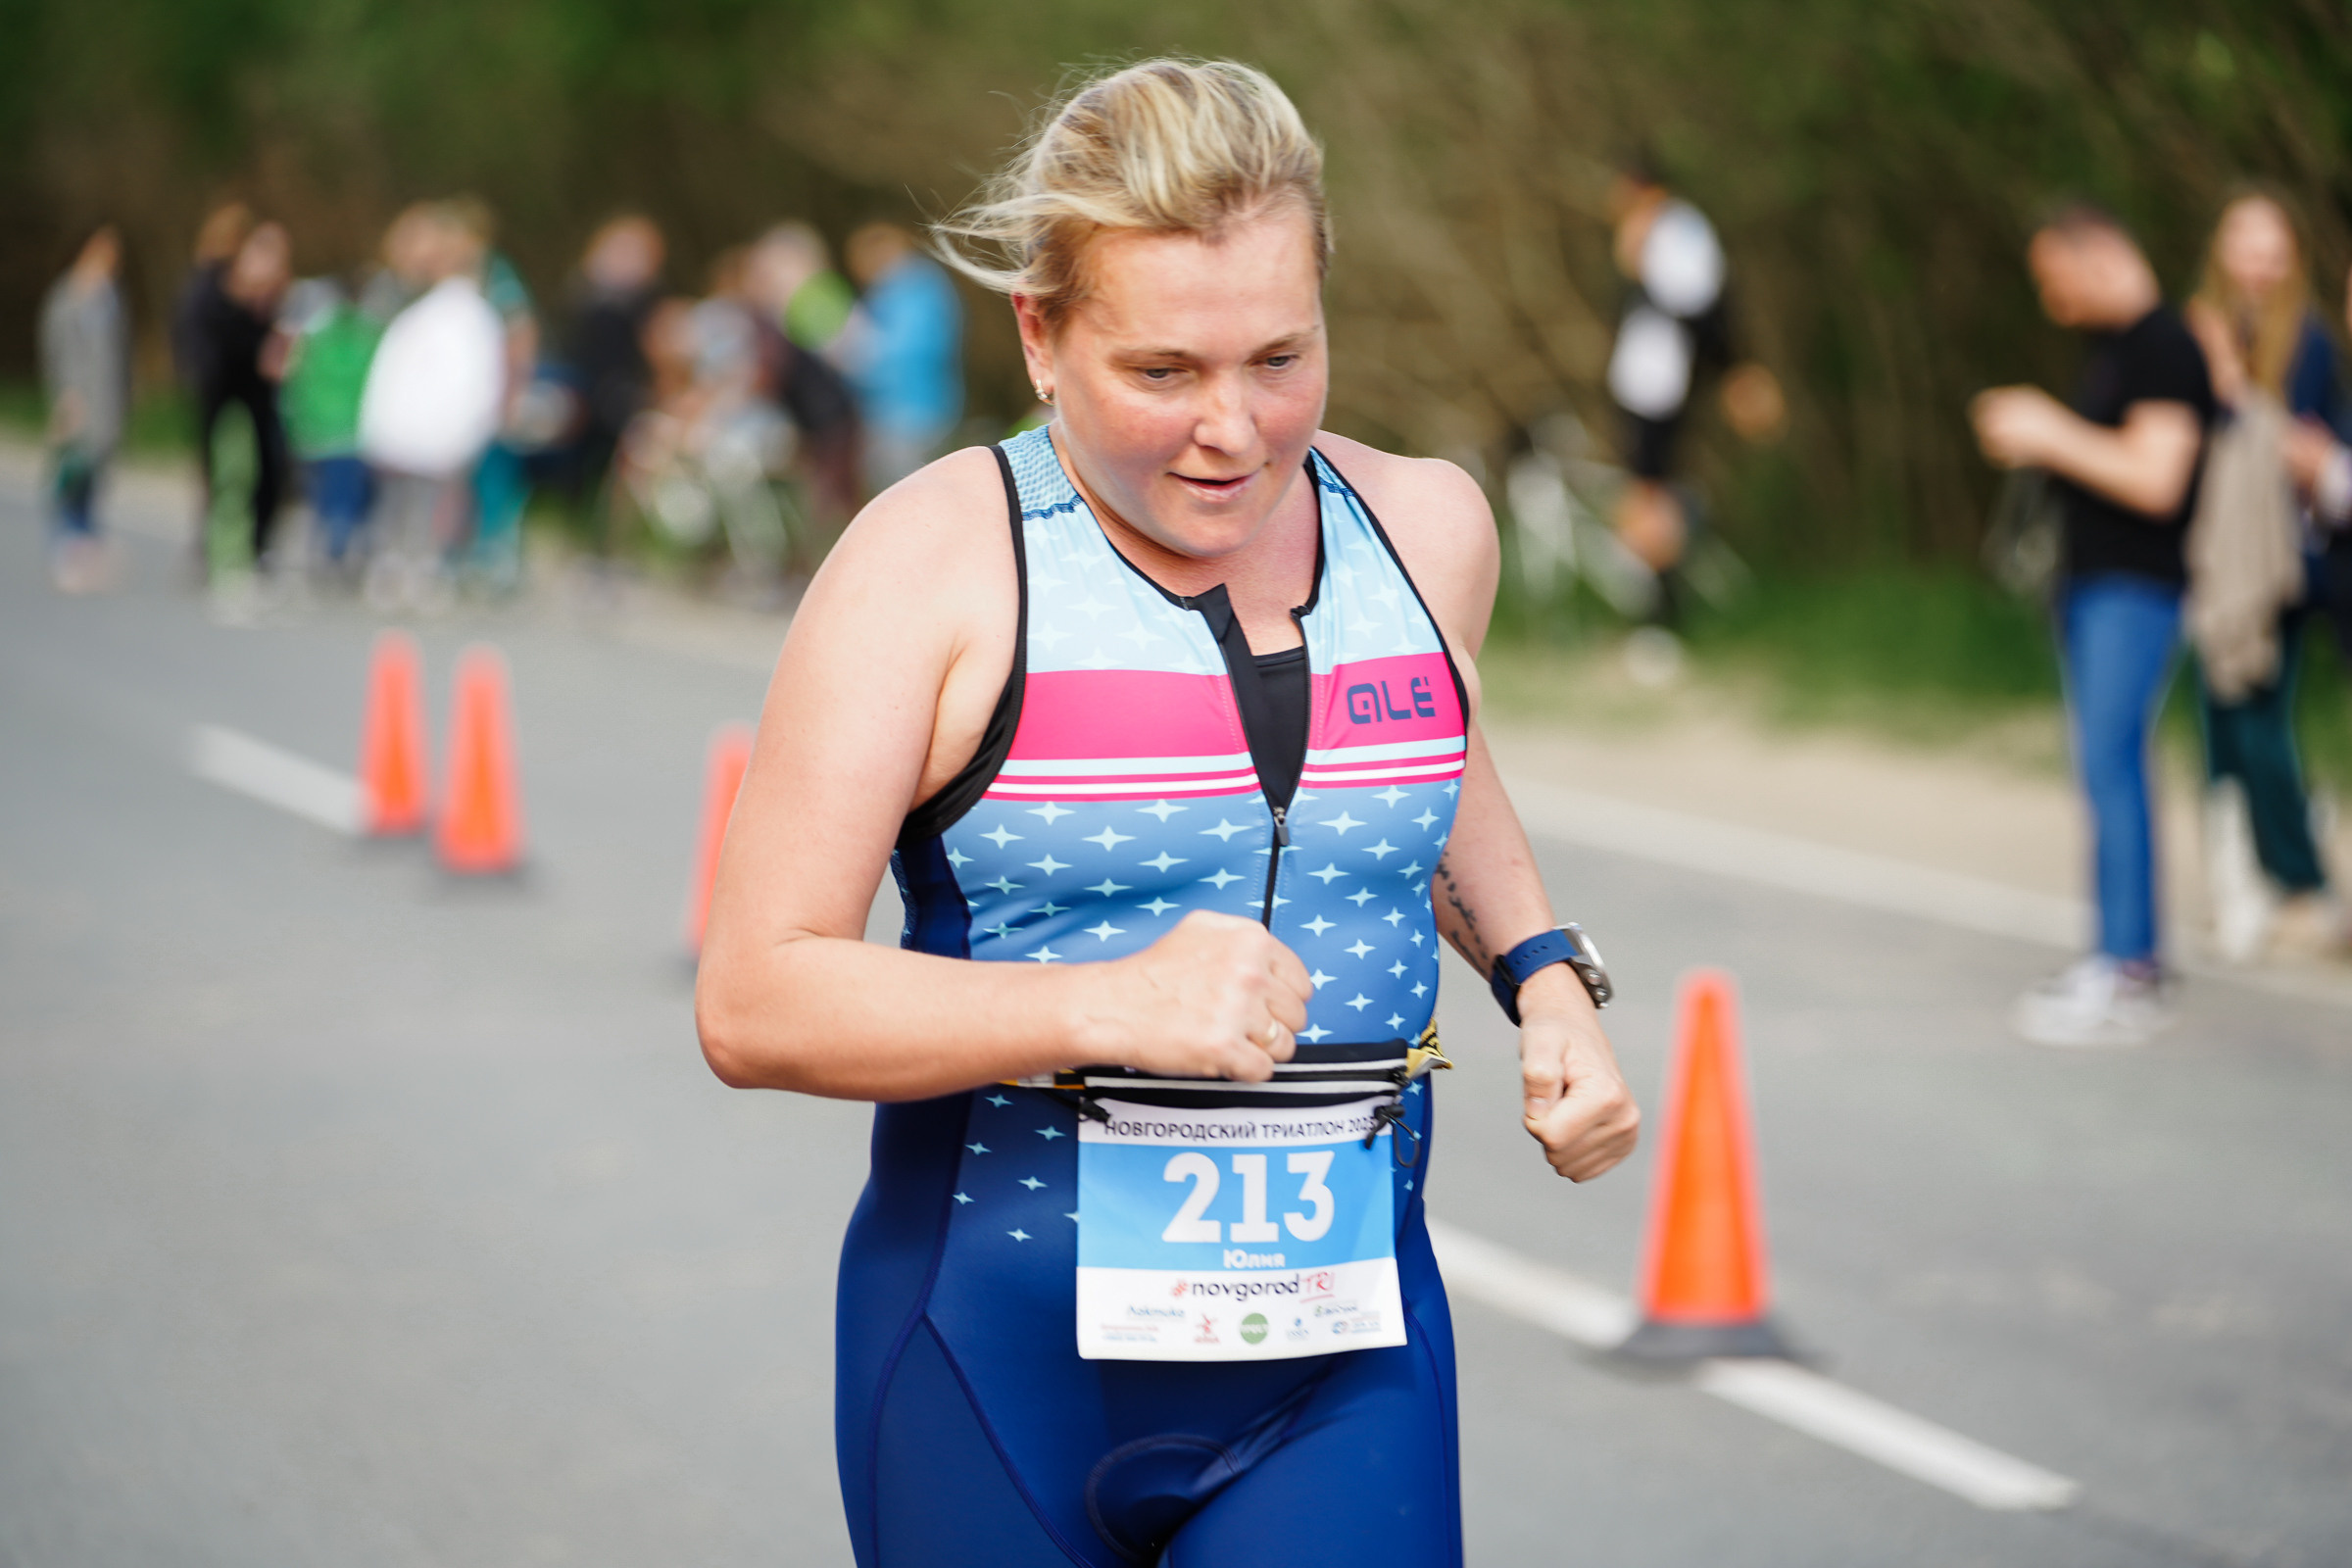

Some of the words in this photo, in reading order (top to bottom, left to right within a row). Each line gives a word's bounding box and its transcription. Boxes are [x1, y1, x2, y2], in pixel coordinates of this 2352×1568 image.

[1104, 1120, 1255, 1141] НОВГОРОДСКИЙ
[1260, 1120, 1346, 1138] ТРИАТЛОН
[1162, 1151, 1335, 1243] 213
[1223, 1249, 1286, 1269] Юлия
